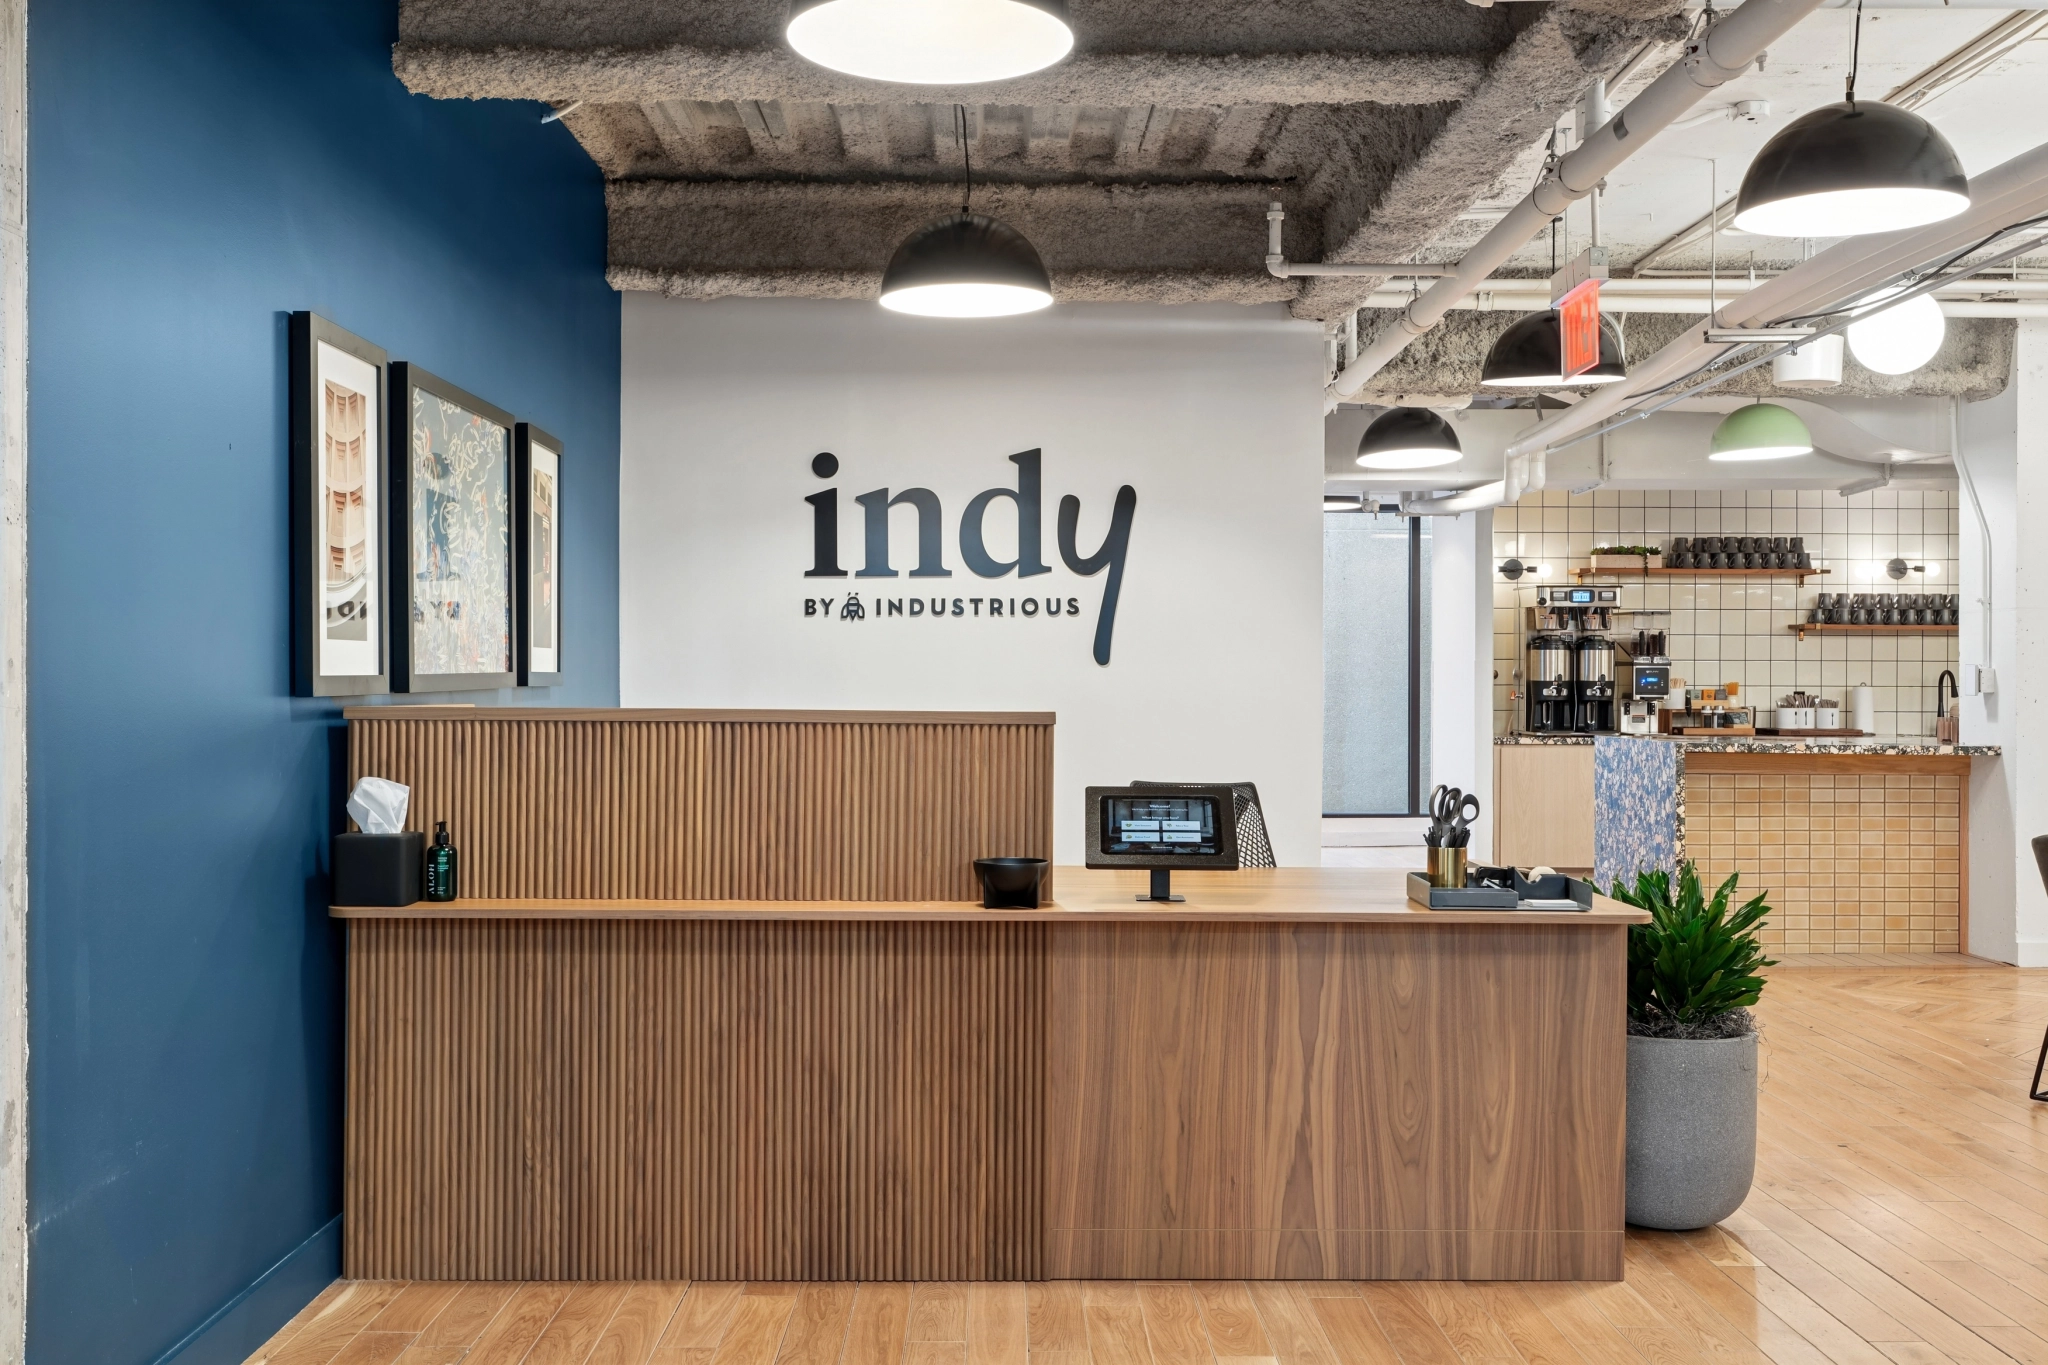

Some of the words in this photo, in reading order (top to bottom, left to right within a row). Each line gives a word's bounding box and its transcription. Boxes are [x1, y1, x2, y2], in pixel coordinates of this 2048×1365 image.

[804, 447, 1137, 666] indy
[804, 598, 835, 616] BY
[876, 597, 1080, 616] INDUSTRIOUS
